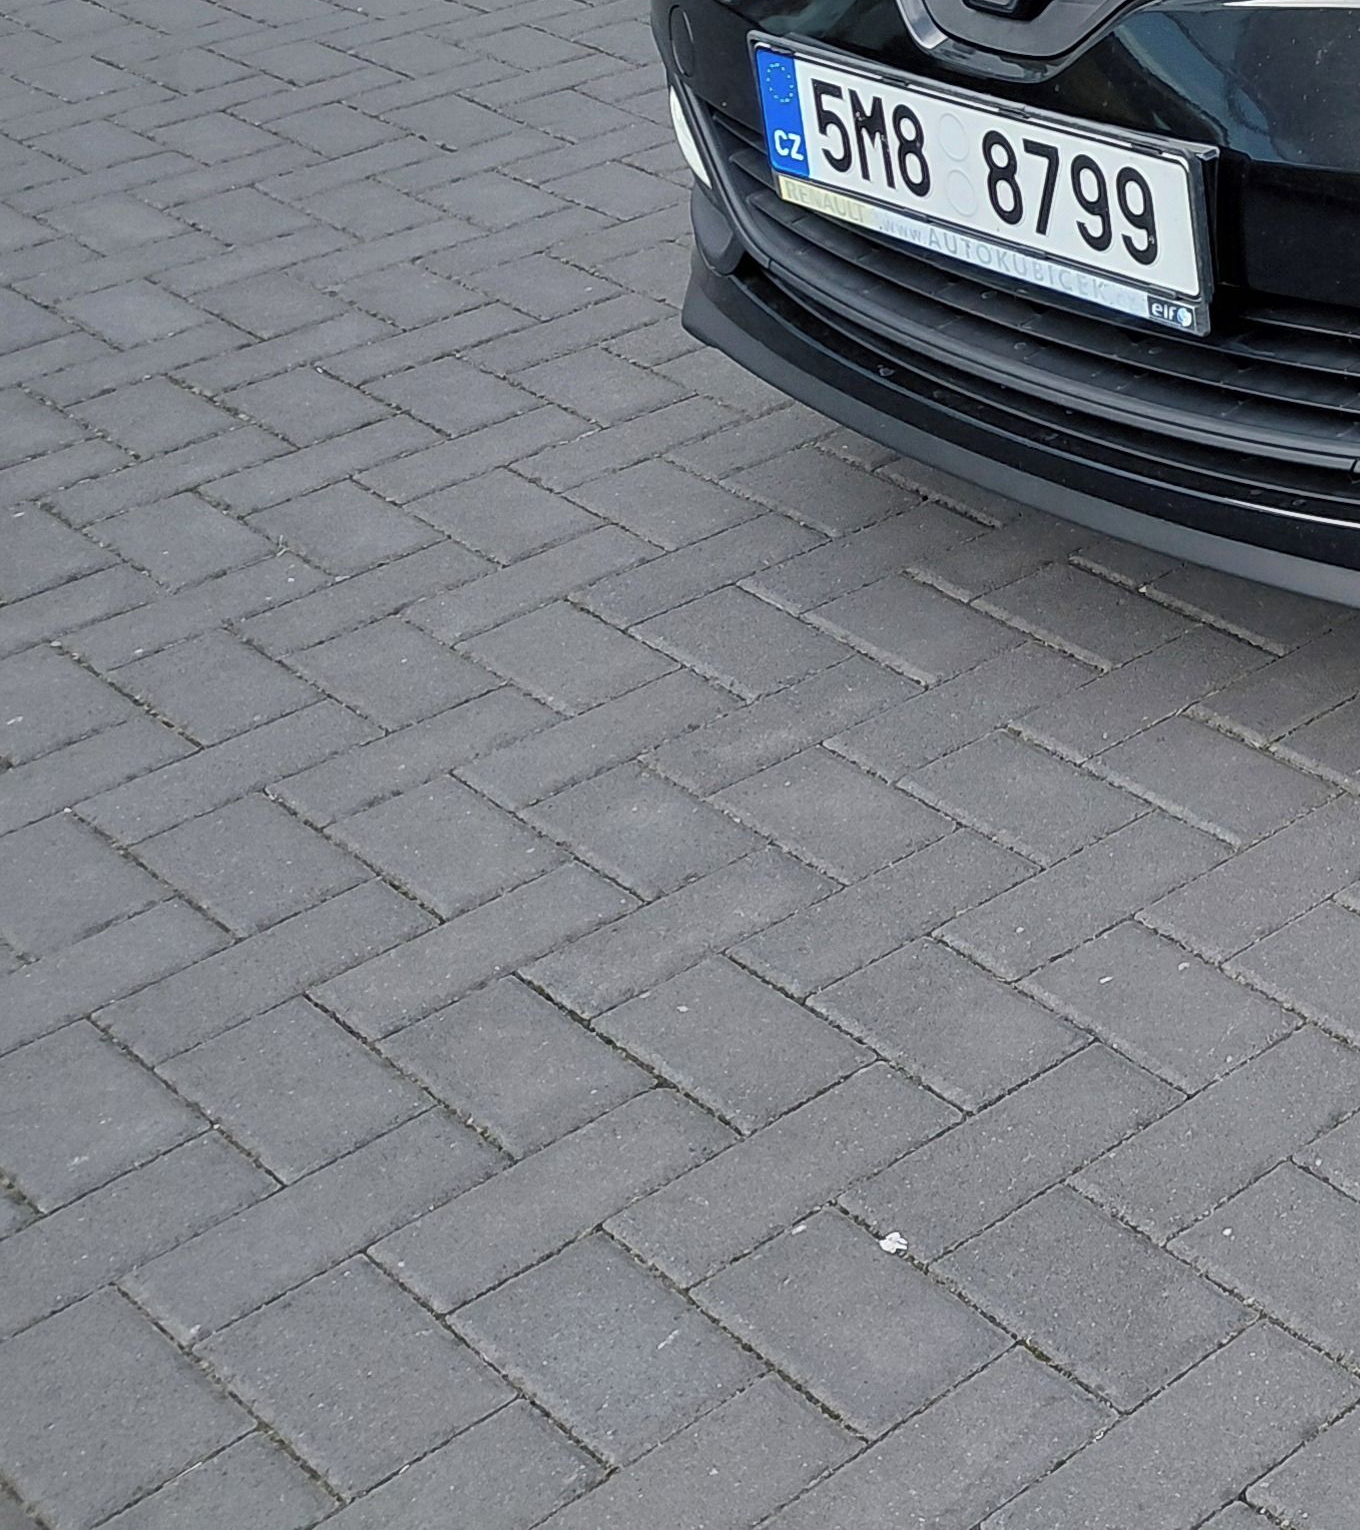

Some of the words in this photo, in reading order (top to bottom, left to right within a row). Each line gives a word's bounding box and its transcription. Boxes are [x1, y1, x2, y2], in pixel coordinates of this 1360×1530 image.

[774, 128, 804, 162] CZ
[811, 78, 931, 198] 5M8
[982, 130, 1158, 266] 8799
[1150, 300, 1177, 319] elf
